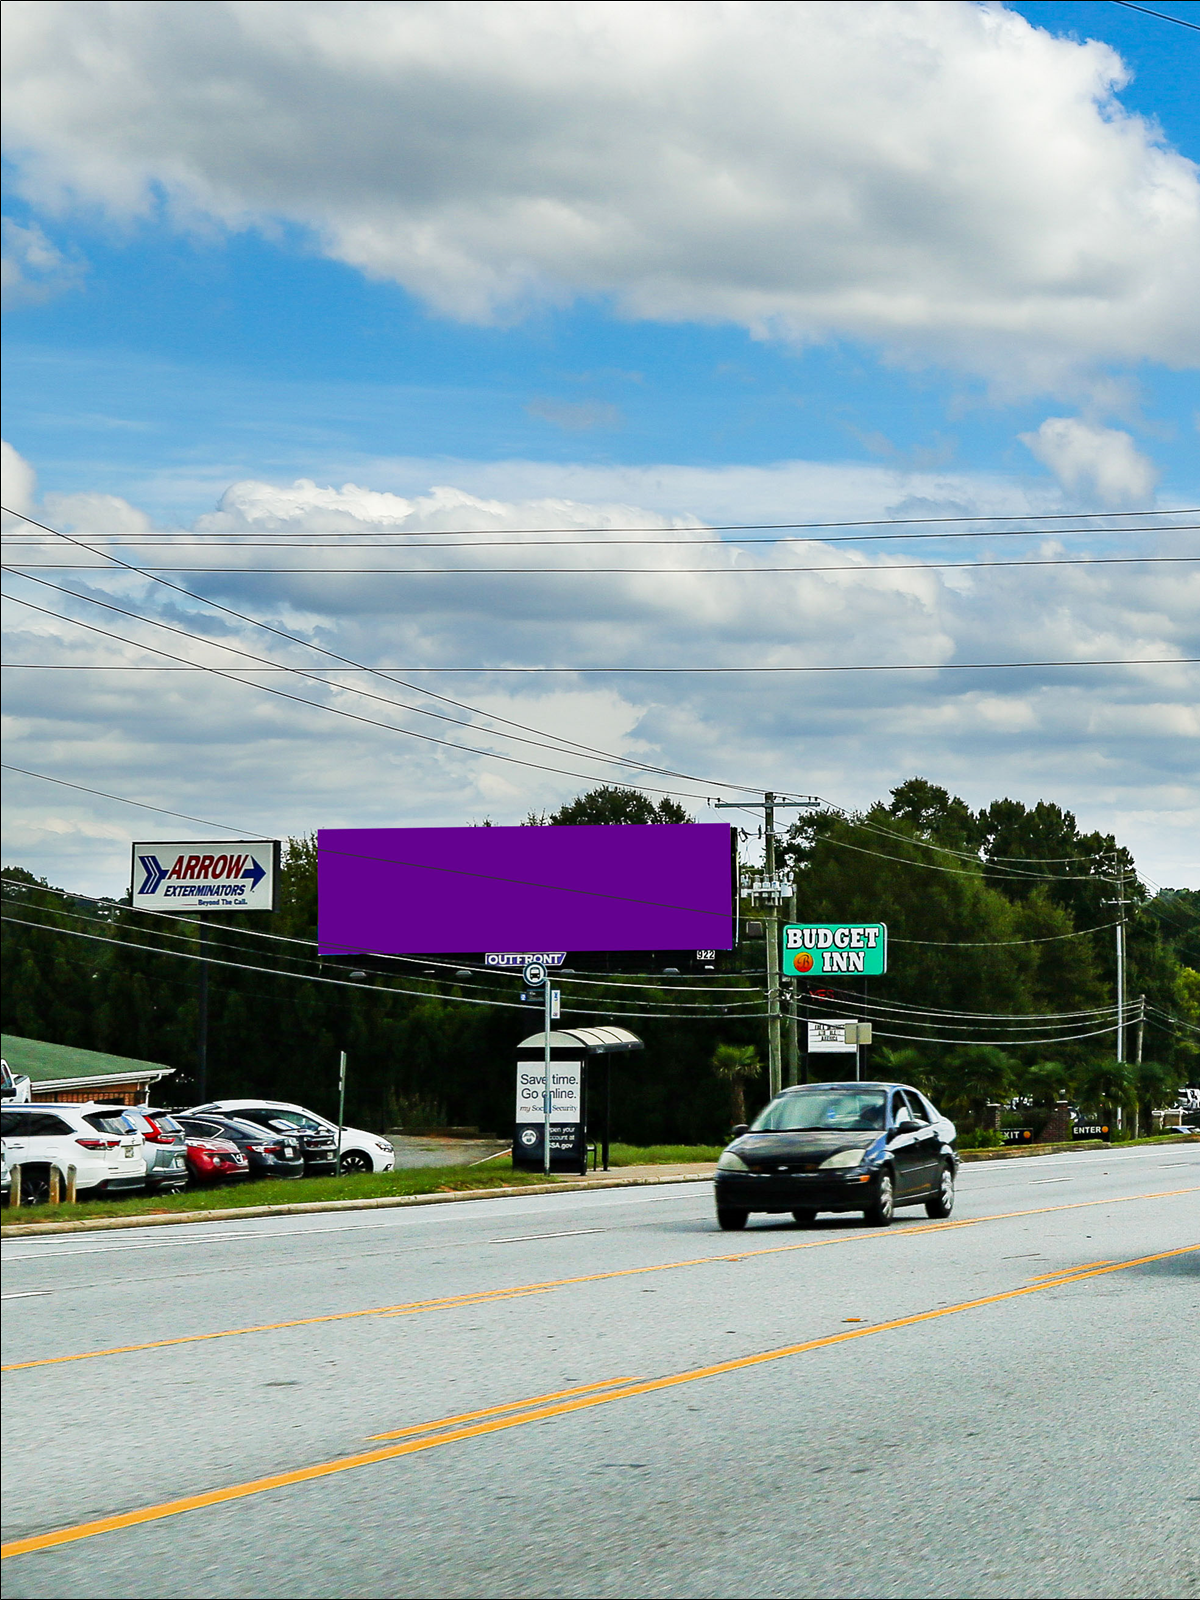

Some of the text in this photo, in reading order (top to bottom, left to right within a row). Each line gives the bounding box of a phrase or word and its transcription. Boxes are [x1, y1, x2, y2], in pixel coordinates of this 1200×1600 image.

[166, 854, 250, 880] ARROW
[163, 884, 247, 897] EXTERMINATORS
[198, 899, 220, 907] Beyond
[786, 927, 880, 949] BUDGET
[488, 953, 562, 965] OUTFRONT
[697, 950, 715, 960] 922
[822, 951, 865, 972] INN
[520, 1073, 579, 1085] Save time.
[521, 1088, 539, 1099] Go
[1073, 1126, 1102, 1135] ENTER
